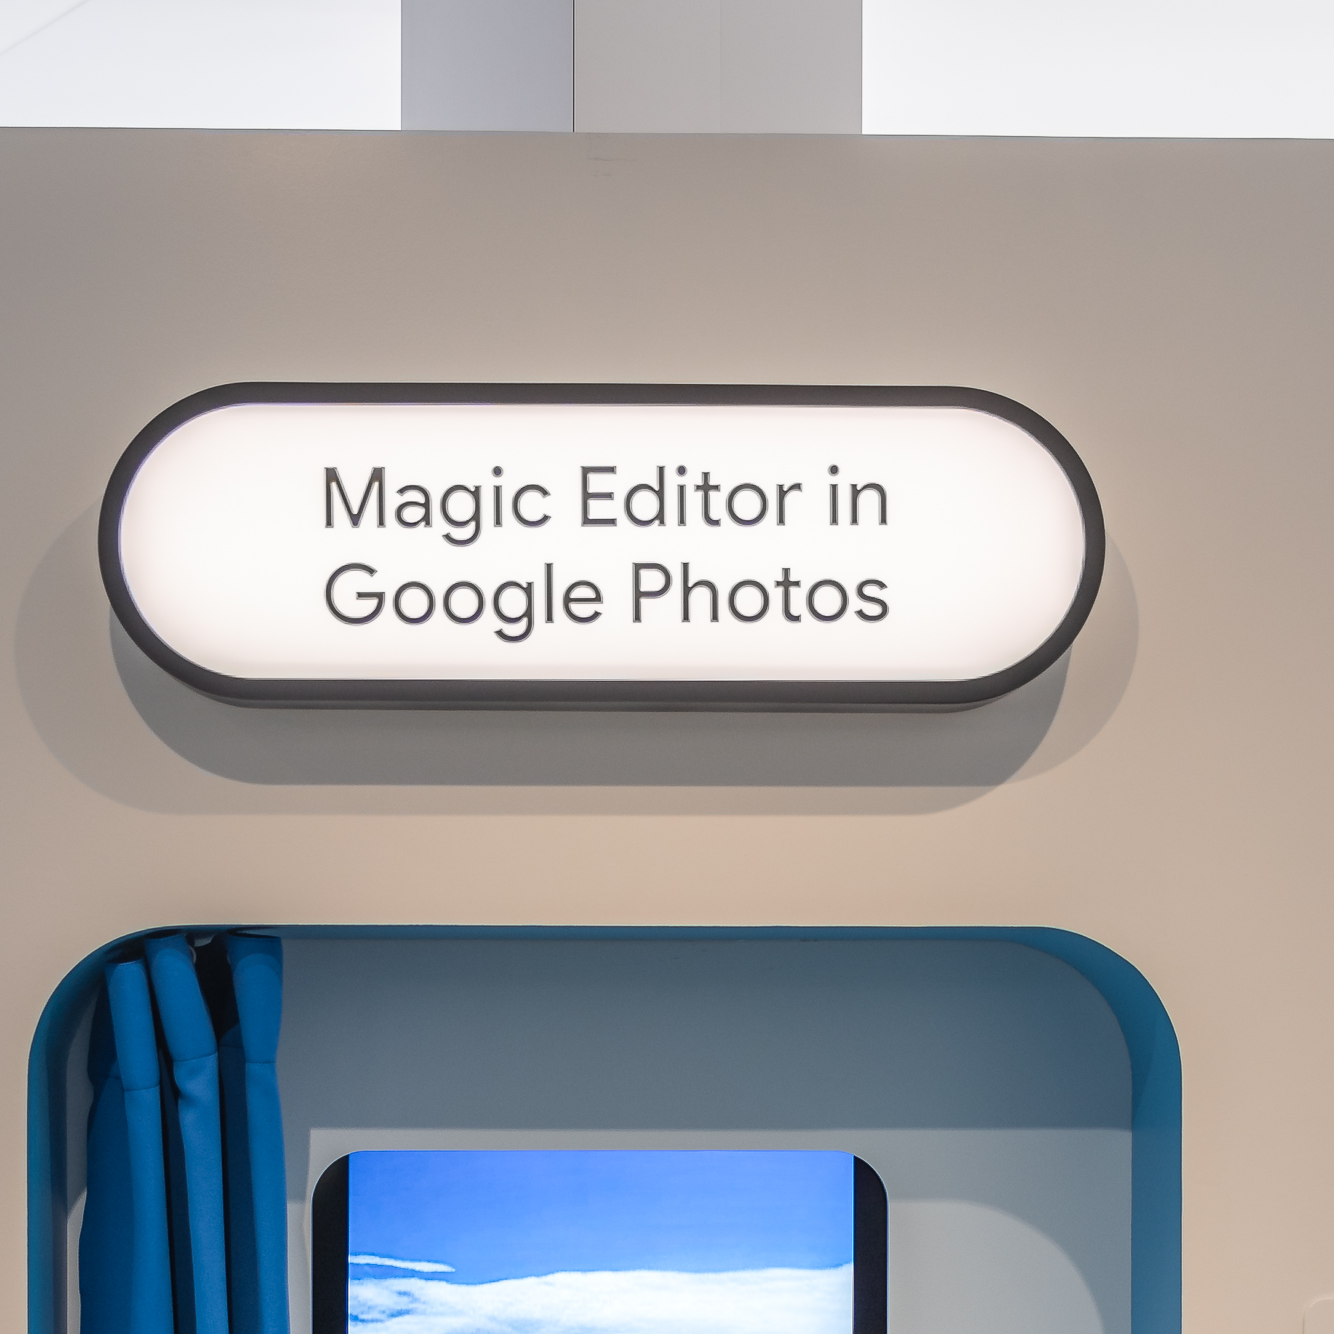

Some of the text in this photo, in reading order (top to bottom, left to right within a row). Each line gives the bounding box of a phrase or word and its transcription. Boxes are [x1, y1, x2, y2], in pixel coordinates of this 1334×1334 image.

[324, 464, 888, 547] Magic Editor in
[325, 562, 890, 643] Google Photos
